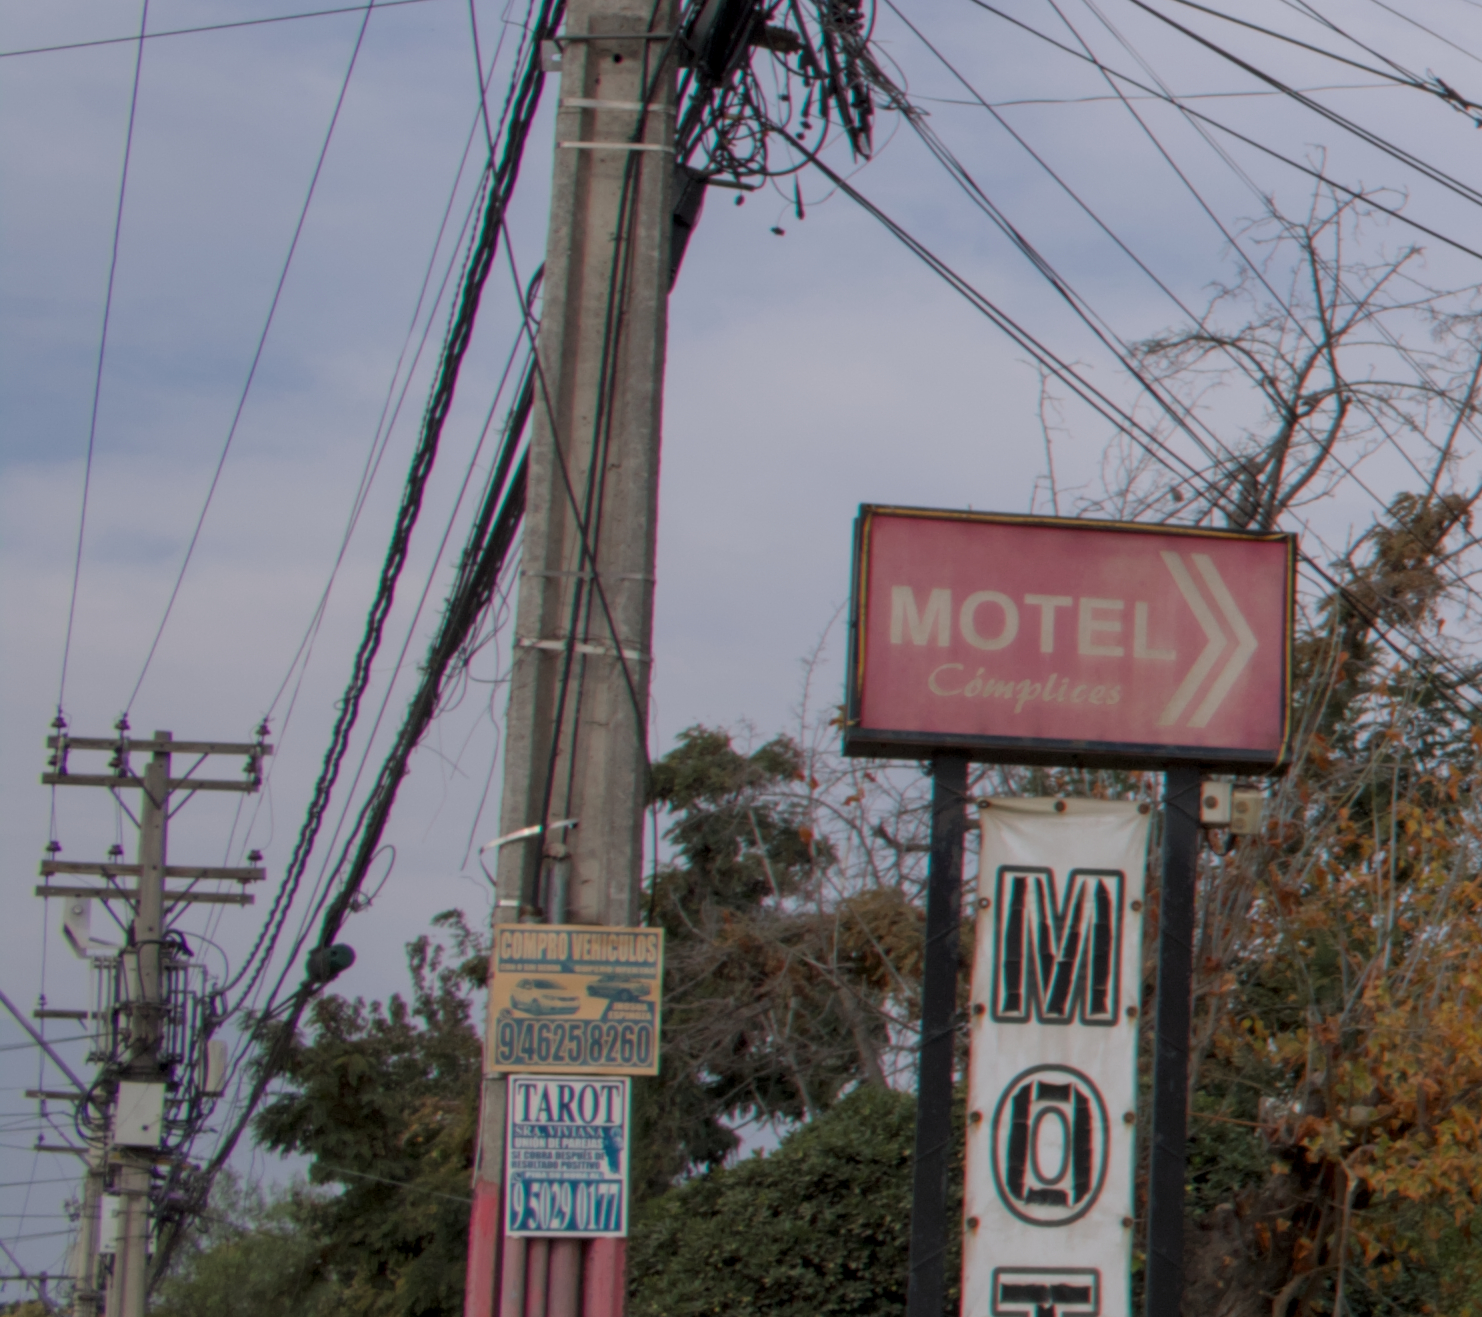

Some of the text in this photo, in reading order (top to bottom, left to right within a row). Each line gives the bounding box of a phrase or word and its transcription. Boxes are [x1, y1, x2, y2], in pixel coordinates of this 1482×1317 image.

[889, 585, 1177, 661] MOTEL
[927, 663, 1122, 714] Cómplices
[500, 931, 657, 963] COMPRO VEHICULOS
[499, 1020, 653, 1066] 9 4625 8260
[518, 1082, 620, 1125] TAROT
[515, 1125, 604, 1137] SRA. VIVIANA
[548, 1137, 561, 1149] DE
[562, 1137, 604, 1149] PAREJAS
[512, 1182, 620, 1230] 9 5029 0177
